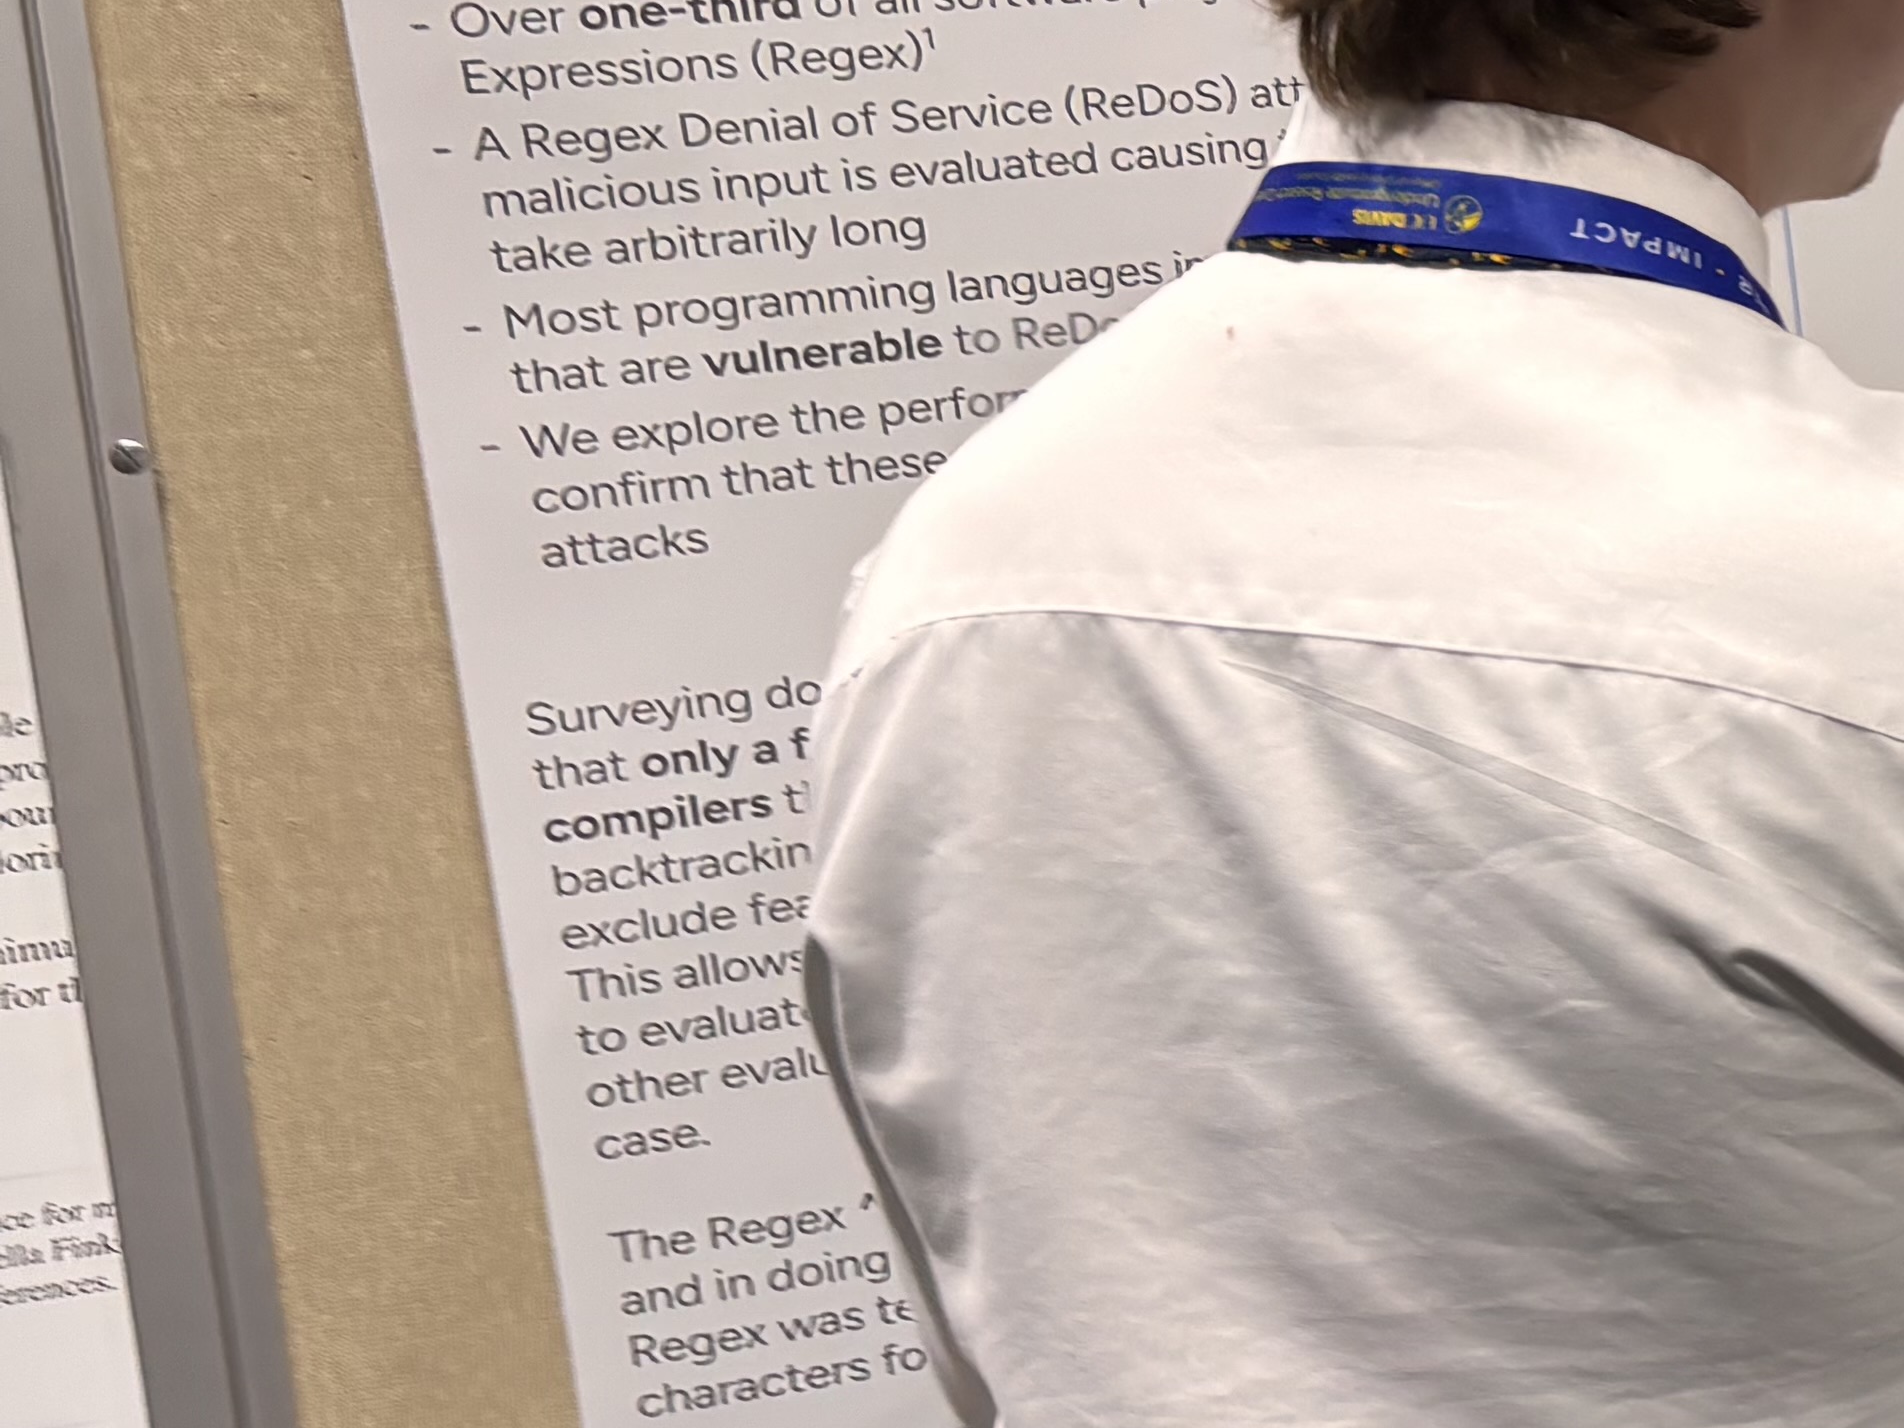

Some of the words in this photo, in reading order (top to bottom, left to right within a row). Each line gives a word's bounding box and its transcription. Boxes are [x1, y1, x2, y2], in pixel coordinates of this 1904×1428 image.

[450, 0, 567, 43] Over
[459, 43, 739, 97] Expressions
[474, 125, 508, 163] A
[520, 119, 667, 164] Regex
[680, 106, 818, 147] Denial
[832, 100, 878, 139] of
[891, 93, 1053, 134] Service
[1064, 76, 1237, 127] (ReDoS)
[490, 236, 597, 275] take
[606, 219, 817, 266] arbitrarily
[831, 209, 926, 254] long
[1569, 215, 1703, 270] IMPACT
[504, 299, 622, 341] Most
[635, 275, 936, 336] programming
[947, 256, 1163, 303] languages
[511, 355, 607, 395] that
[618, 348, 692, 386] are
[701, 329, 943, 375] vulnerable
[541, 522, 710, 570] attacks
[526, 683, 753, 739] Surveying
[543, 790, 772, 845] compilers
[636, 1352, 872, 1419] characters
